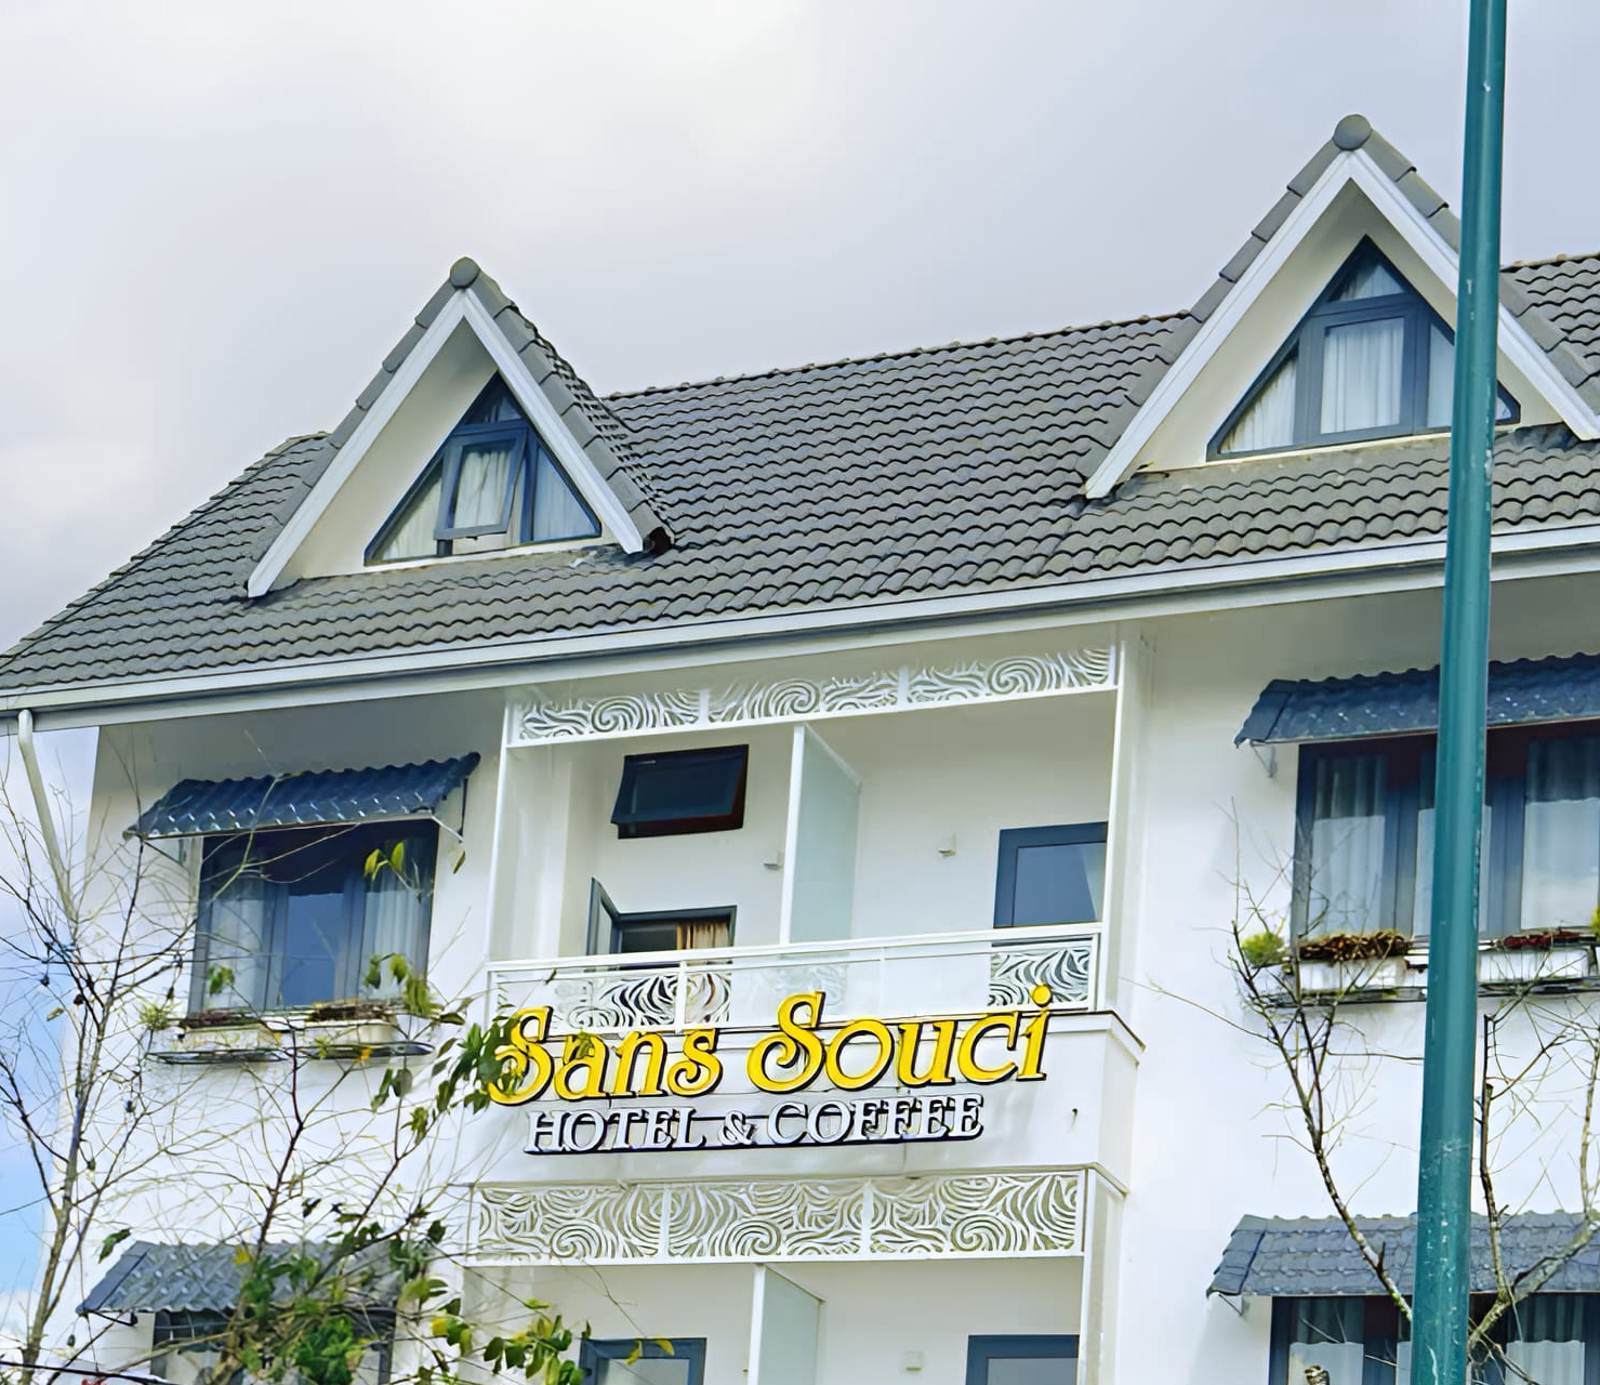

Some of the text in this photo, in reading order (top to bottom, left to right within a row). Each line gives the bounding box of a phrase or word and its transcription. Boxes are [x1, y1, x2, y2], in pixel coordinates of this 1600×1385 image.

[487, 984, 1052, 1106] Sans Souci
[523, 1093, 984, 1154] HOTEL & COFFEE
